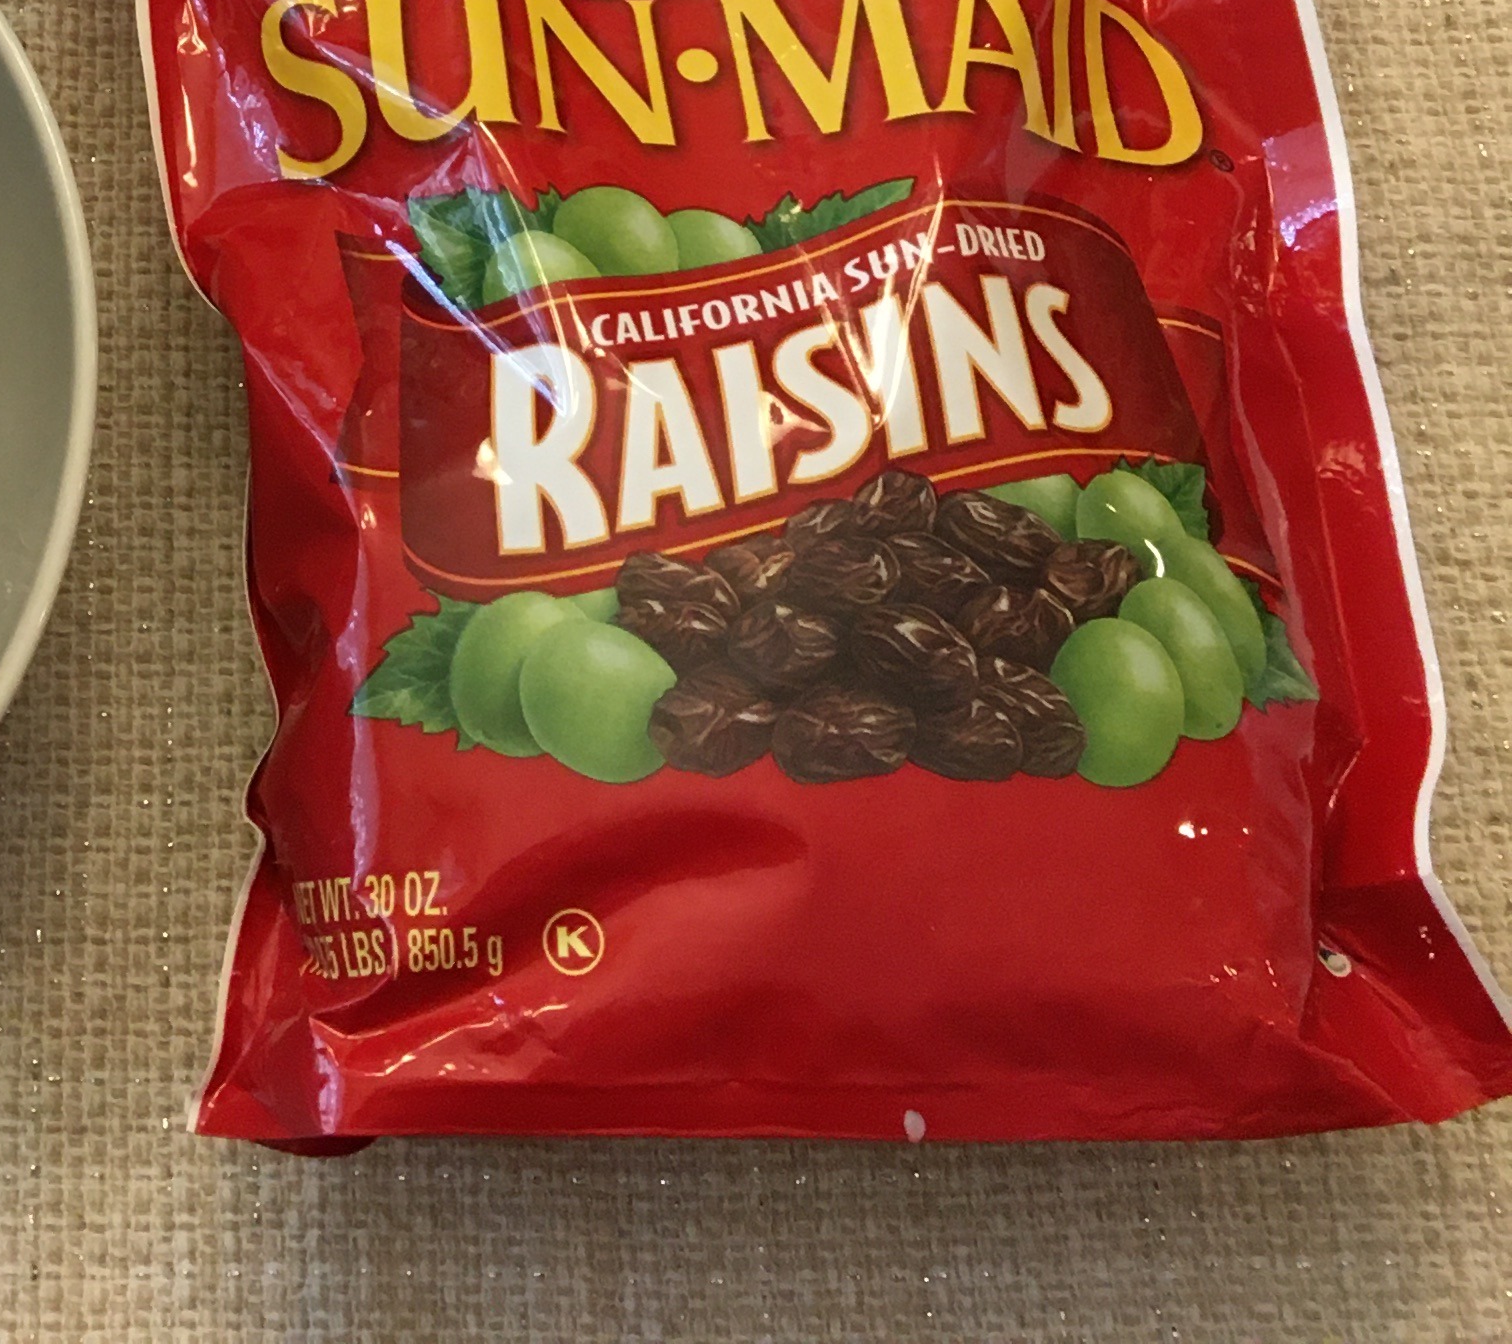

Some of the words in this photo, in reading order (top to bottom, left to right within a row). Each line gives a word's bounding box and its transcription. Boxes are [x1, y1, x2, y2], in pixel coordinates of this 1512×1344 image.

[591, 271, 840, 349] CALIFORNIA
[842, 224, 1047, 293] SUN-DRIED
[487, 273, 1115, 558] RAISINS
[318, 877, 361, 923] WT.
[364, 874, 396, 919] 30
[404, 870, 448, 917] OZ.
[407, 926, 479, 973] 850.5
[488, 934, 504, 977] g
[555, 925, 595, 959] K
